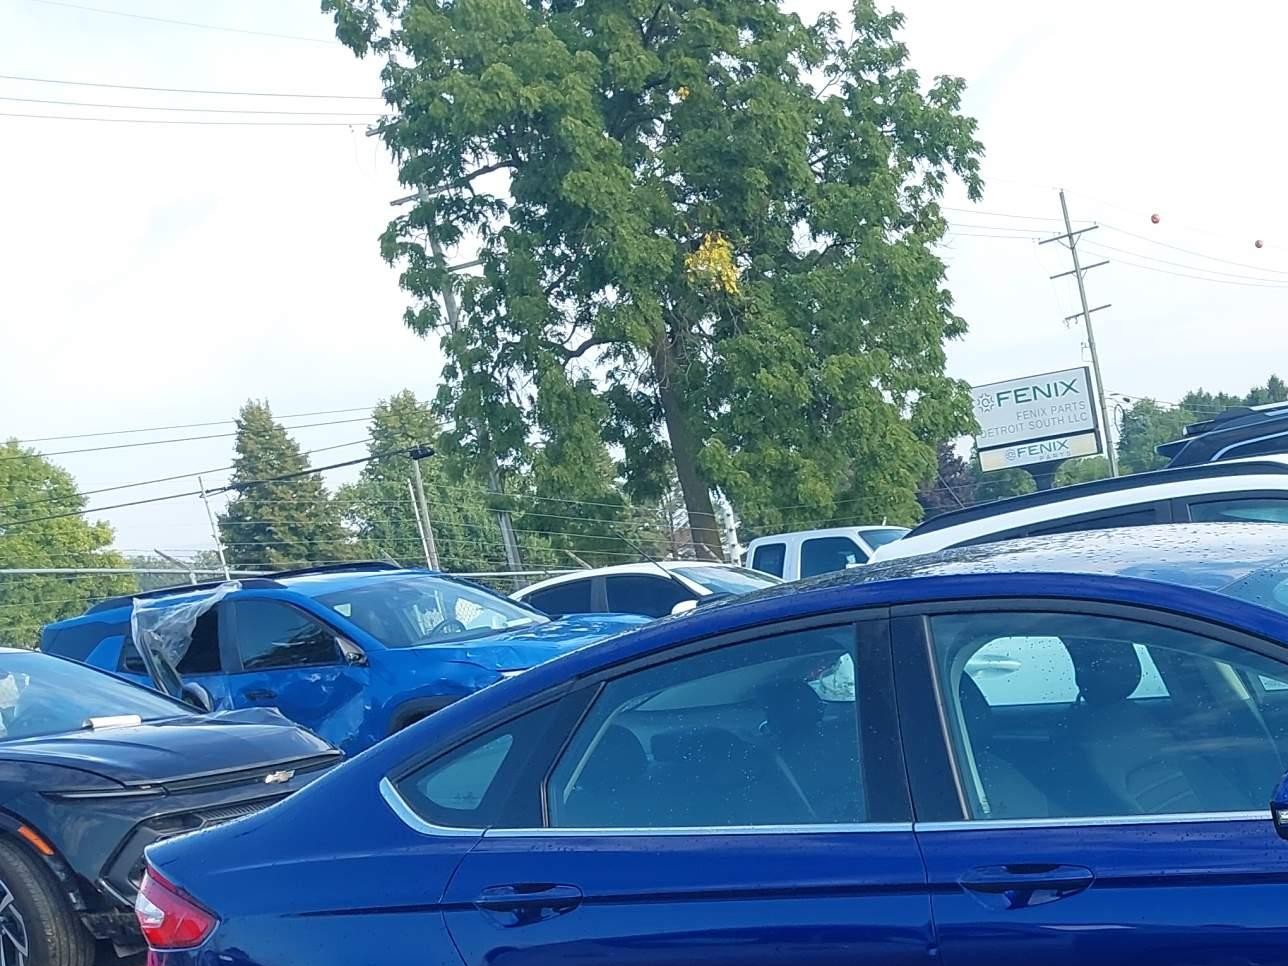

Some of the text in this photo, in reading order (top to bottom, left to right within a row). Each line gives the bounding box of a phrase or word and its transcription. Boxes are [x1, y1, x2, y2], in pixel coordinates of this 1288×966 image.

[996, 378, 1080, 408] FENIX
[1016, 400, 1086, 421] FENIX PARTS
[981, 412, 1088, 439] DETROIT SOUTH LLC
[1017, 440, 1070, 458] FENIX
